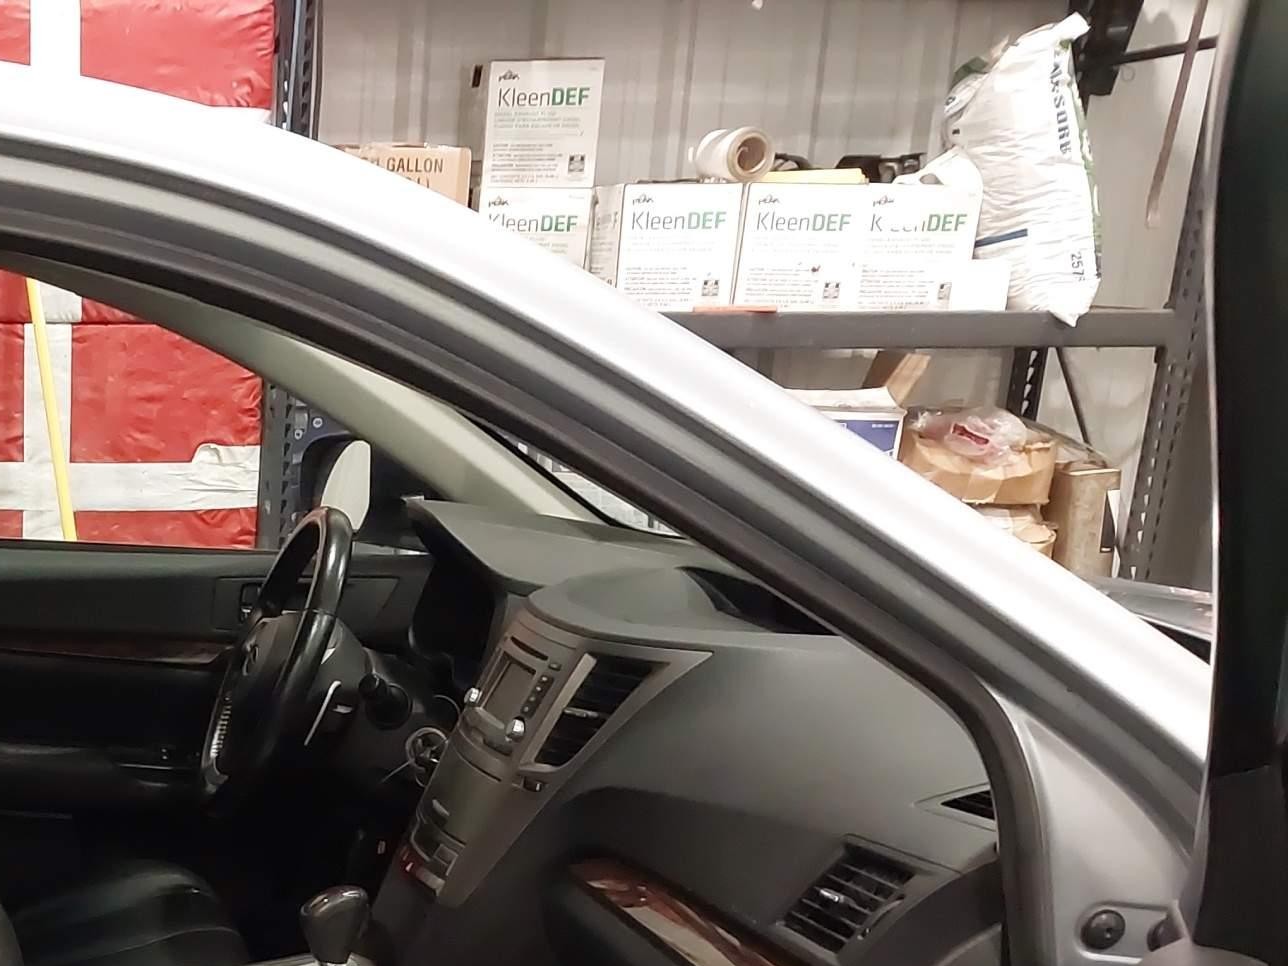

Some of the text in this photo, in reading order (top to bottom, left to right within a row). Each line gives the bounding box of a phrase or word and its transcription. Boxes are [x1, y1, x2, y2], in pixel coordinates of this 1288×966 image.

[498, 87, 590, 107] KleenDEF
[386, 157, 444, 173] GALLON
[632, 211, 727, 230] KleenDEF
[757, 212, 852, 231] KleenDEF
[870, 213, 968, 232] KDEF
